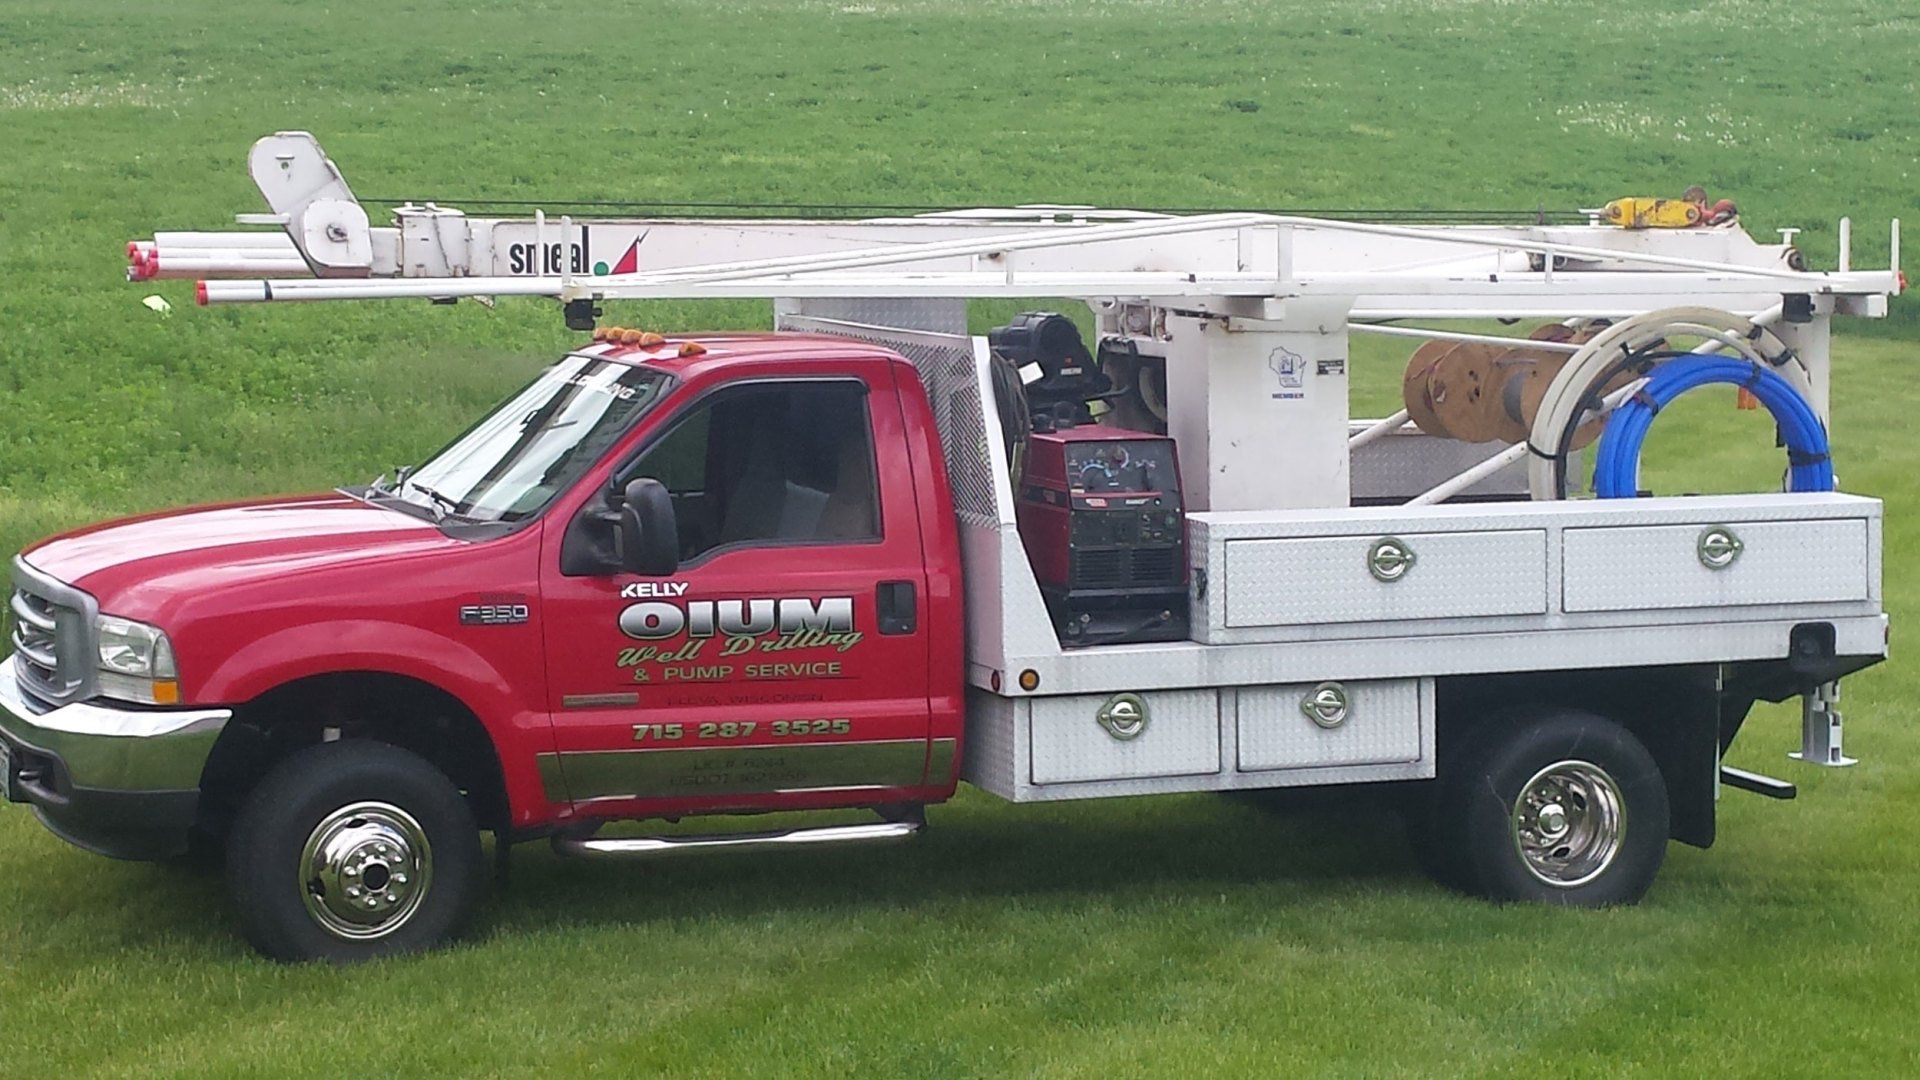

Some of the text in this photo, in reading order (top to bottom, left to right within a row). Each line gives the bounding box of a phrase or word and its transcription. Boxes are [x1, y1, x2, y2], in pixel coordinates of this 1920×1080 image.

[621, 583, 689, 598] KELLY
[619, 597, 853, 640] OIUM
[616, 629, 865, 667] Well Drilling
[633, 661, 842, 681] & PUMP SERVICE
